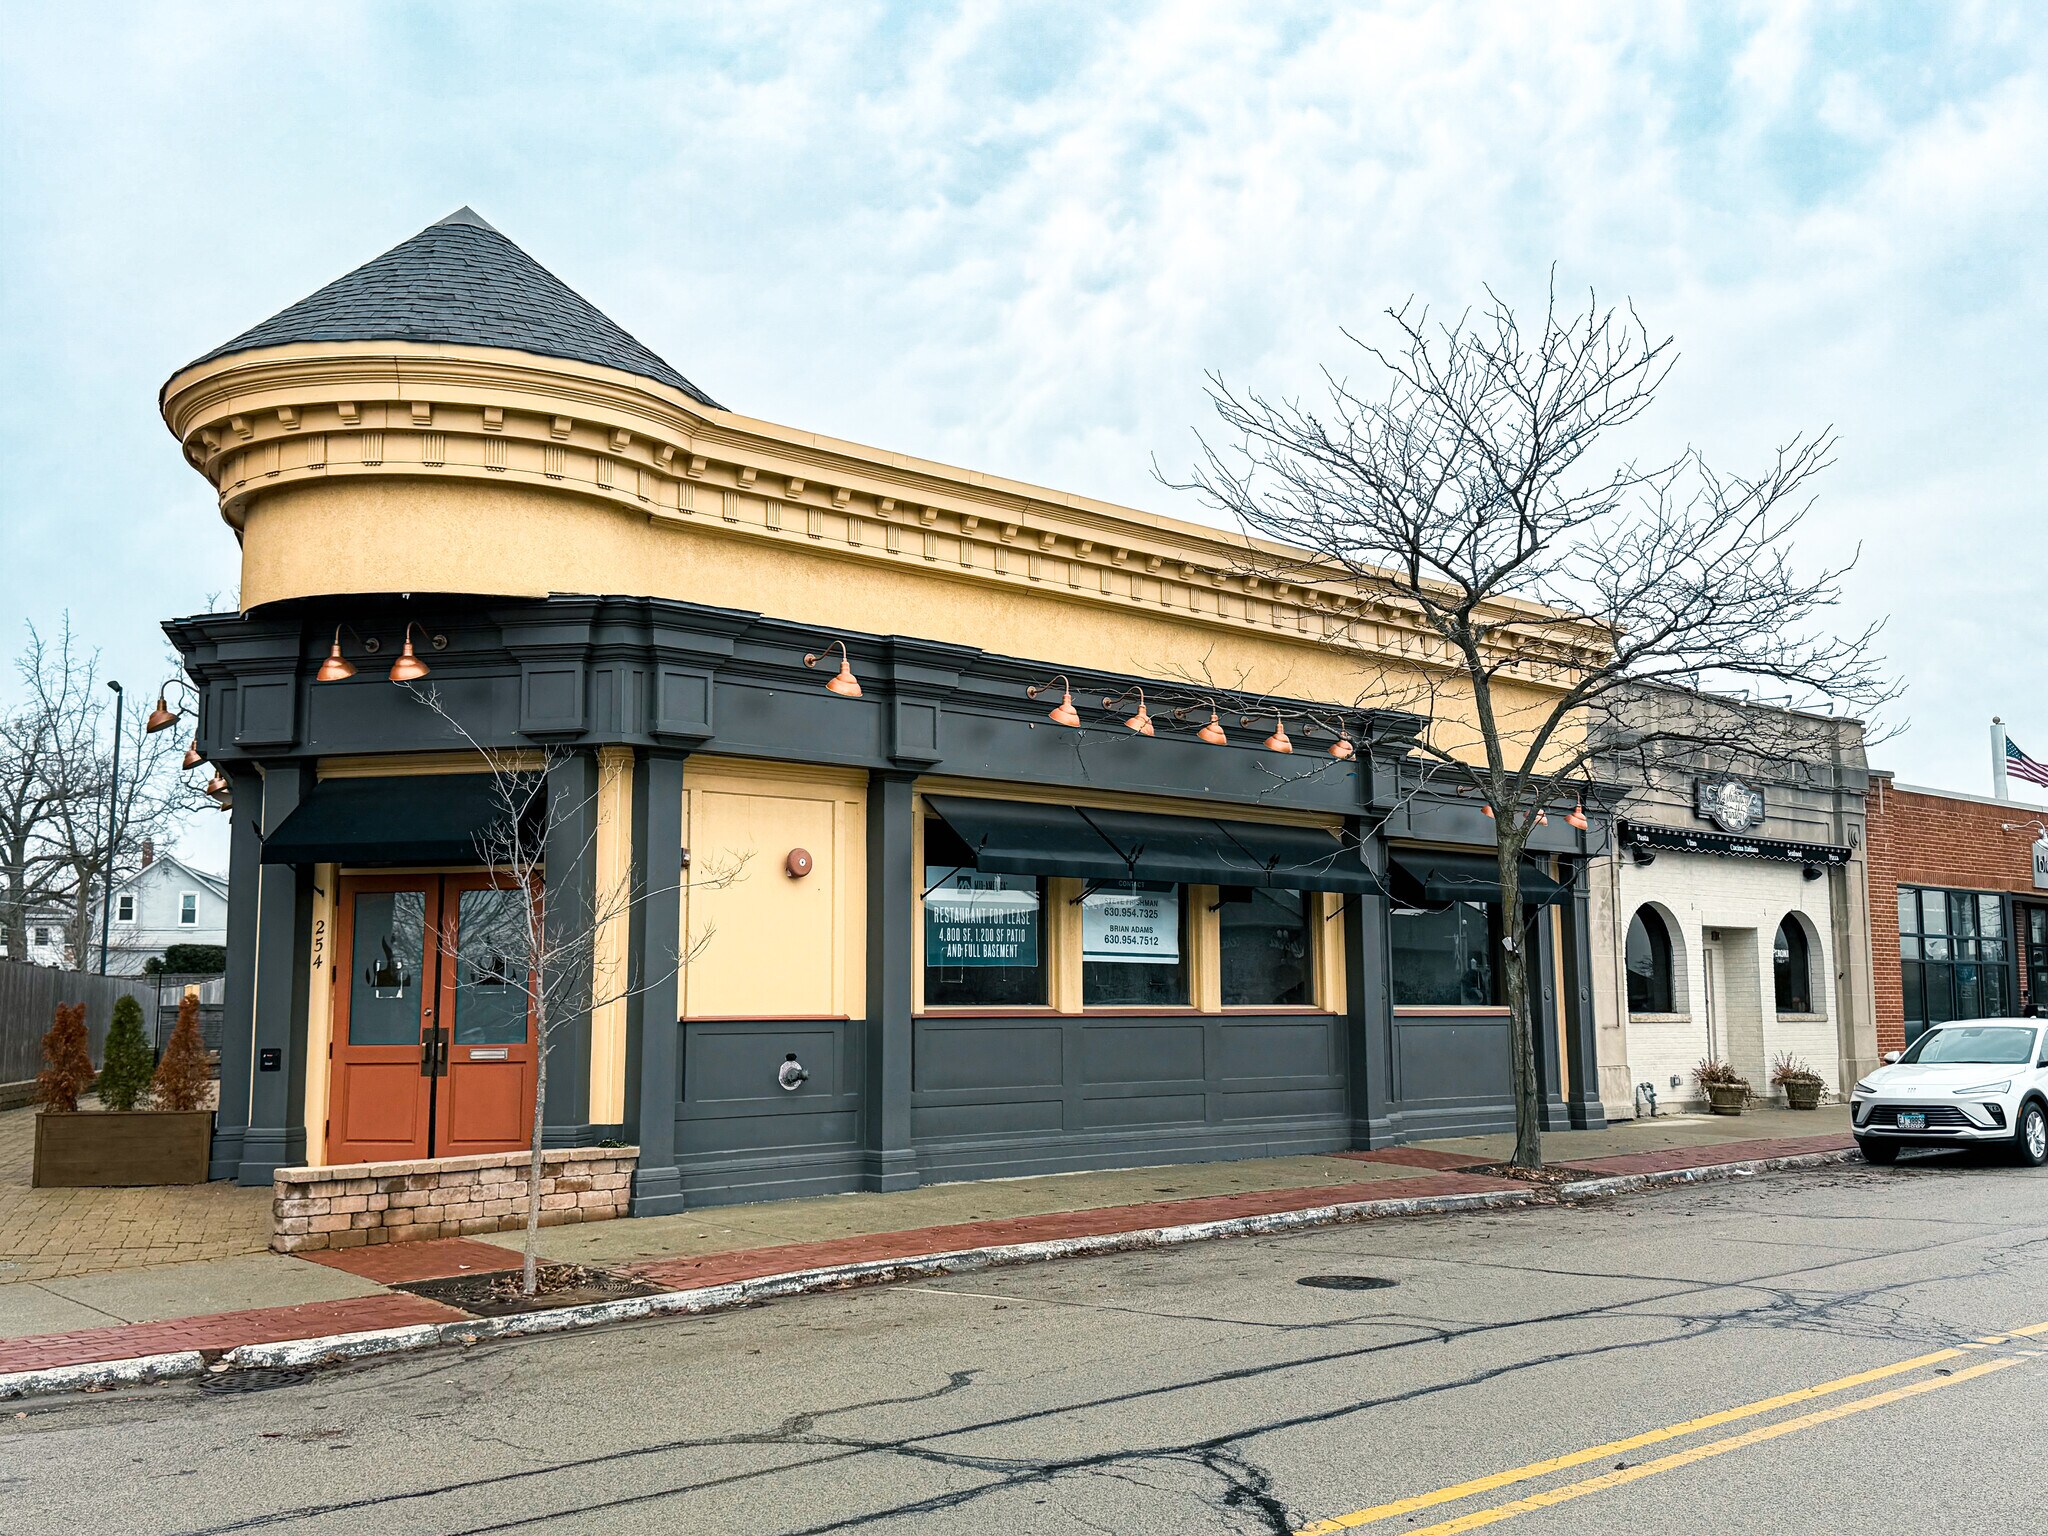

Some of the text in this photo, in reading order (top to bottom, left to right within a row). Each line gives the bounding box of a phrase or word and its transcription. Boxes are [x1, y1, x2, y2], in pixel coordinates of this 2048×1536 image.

[1636, 833, 1650, 842] Pasta
[974, 880, 1007, 891] MID-AMECA
[1118, 880, 1145, 888] CONTCT
[933, 906, 1031, 925] RESTAURANT FOR LEASE
[1104, 907, 1159, 919] 630.954.7325
[1109, 924, 1154, 934] BRIAN ADAMS
[996, 928, 1005, 942] SF
[1006, 929, 1026, 943] PATIO
[1104, 934, 1159, 946] 630.954.7512
[313, 920, 325, 970] 254
[946, 944, 1018, 958] AND FULL BASEMENT
